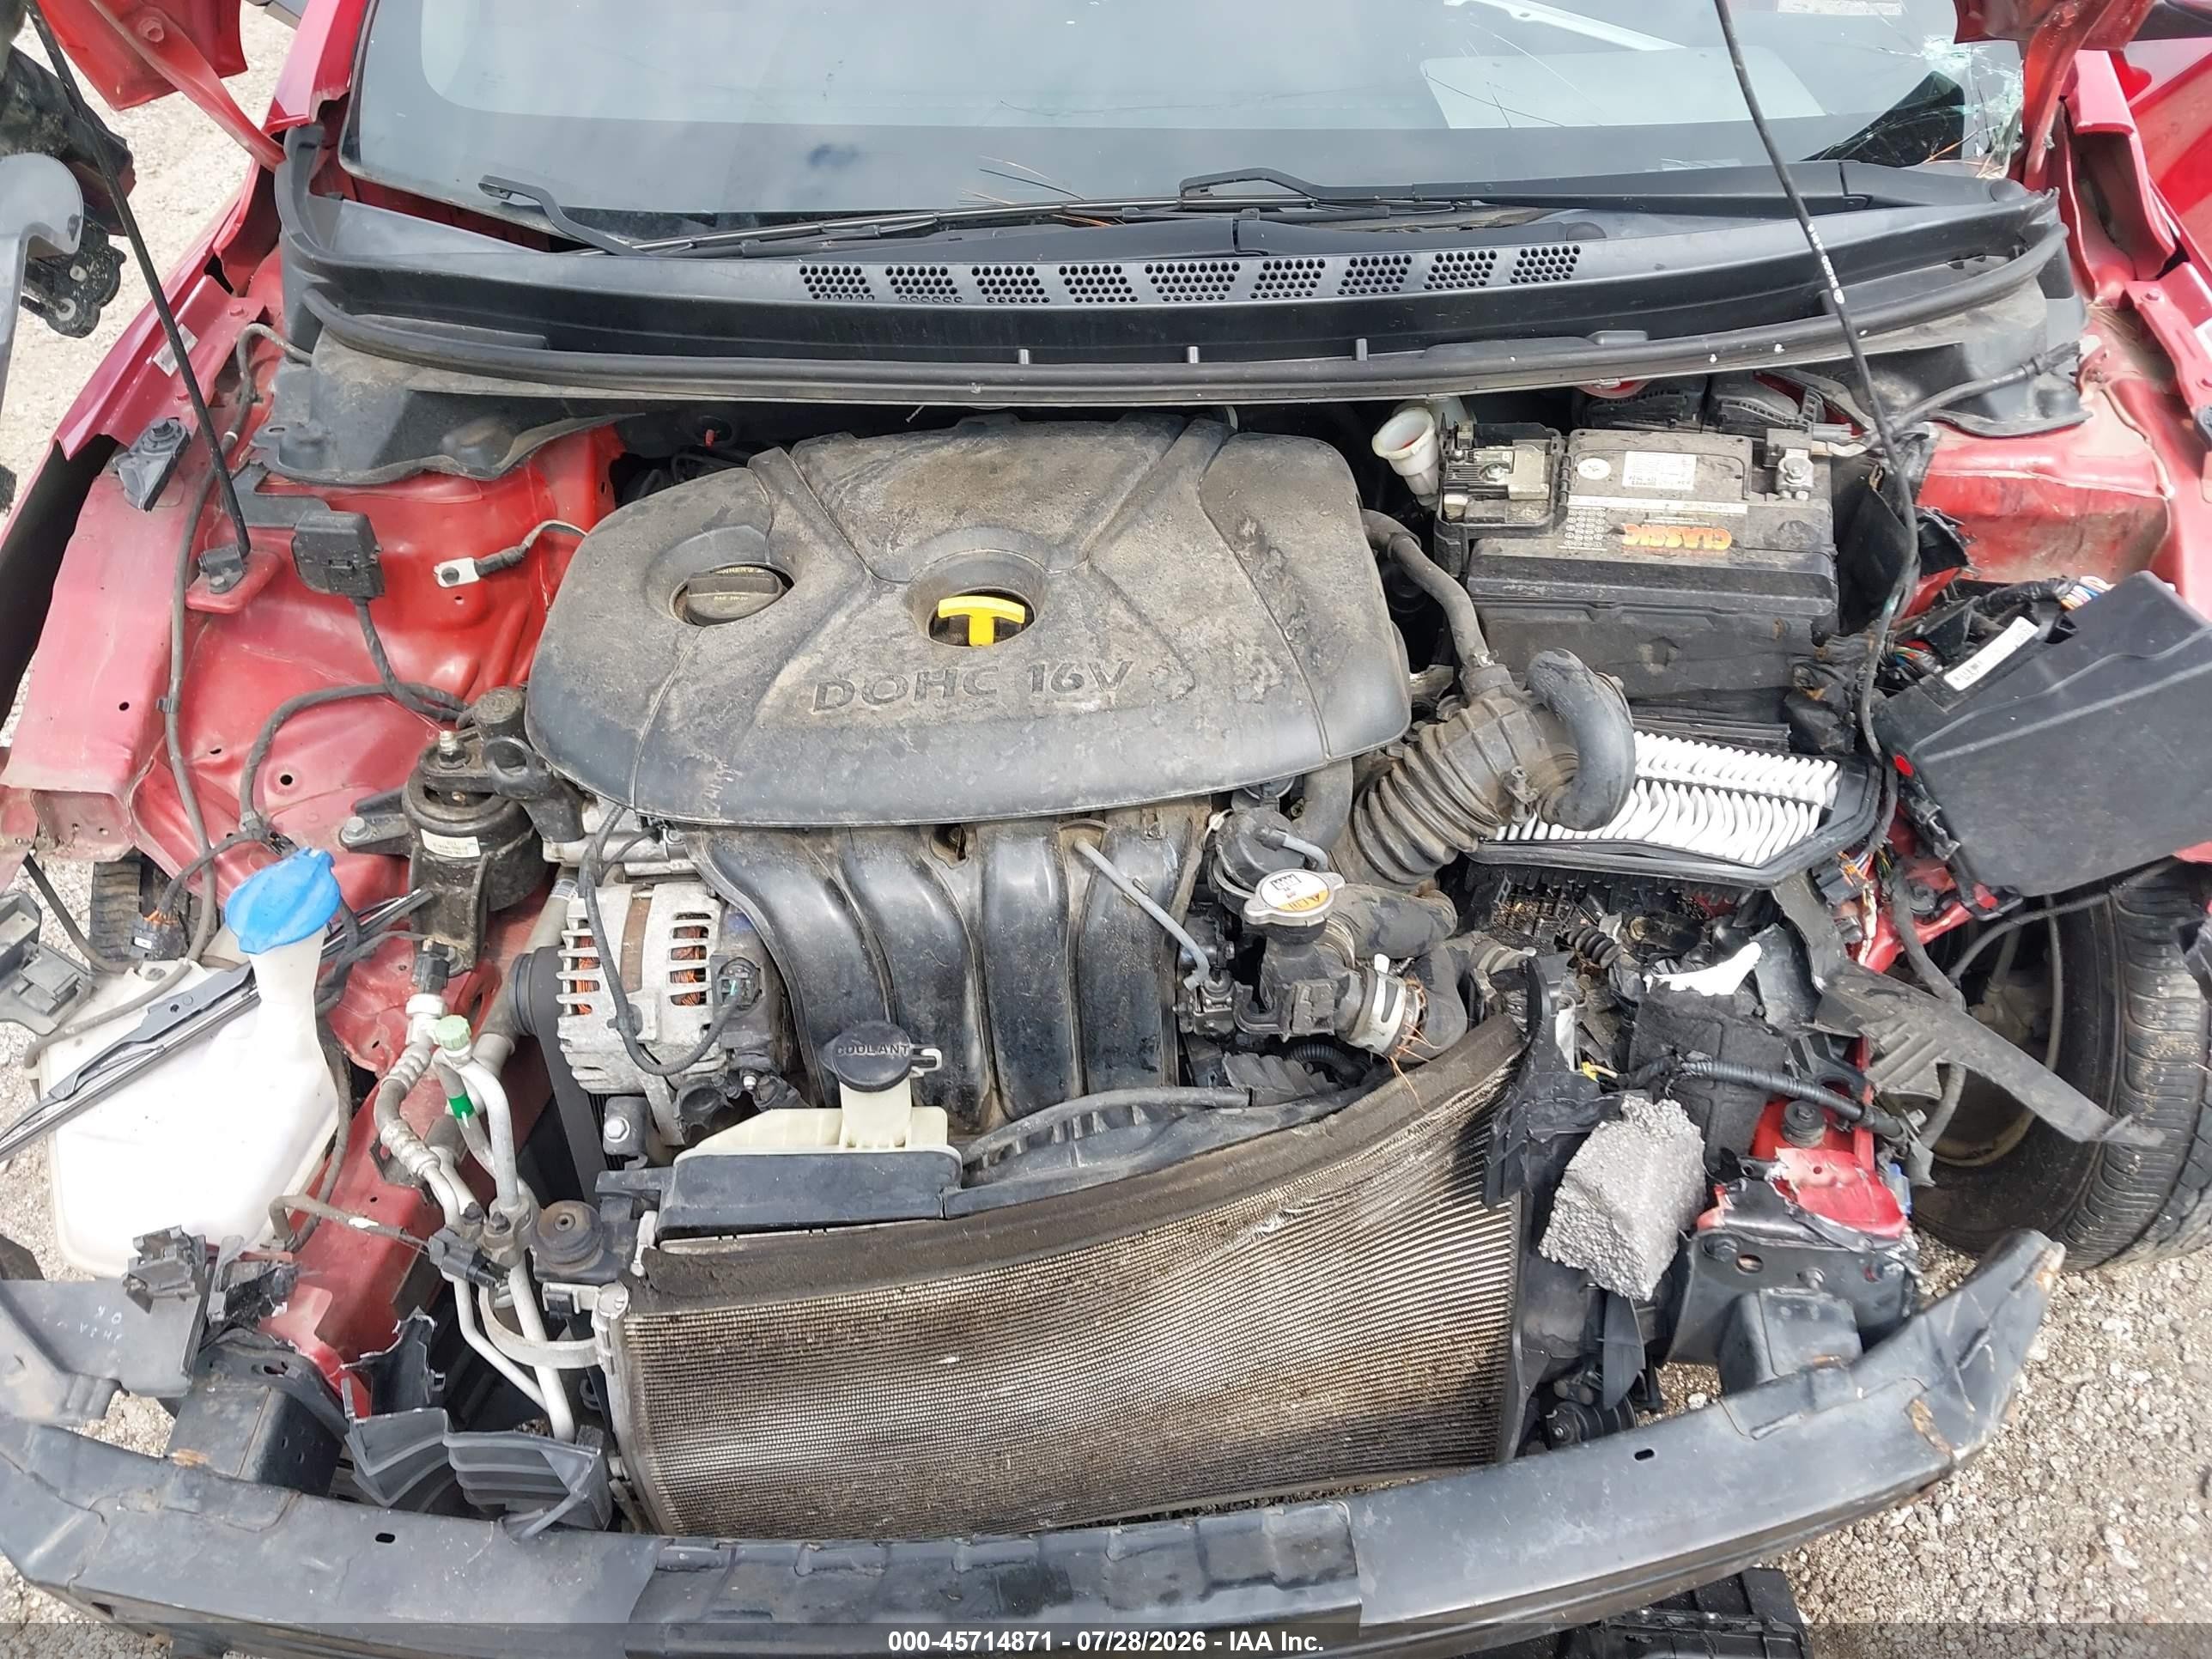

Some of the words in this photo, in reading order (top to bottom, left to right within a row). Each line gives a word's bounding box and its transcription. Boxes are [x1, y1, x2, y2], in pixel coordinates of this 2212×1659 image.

[1621, 522, 1732, 550] CLASSIC
[812, 665, 1000, 714] DOHC
[1026, 659, 1133, 695] 16V
[836, 1043, 910, 1056] COOLANT
